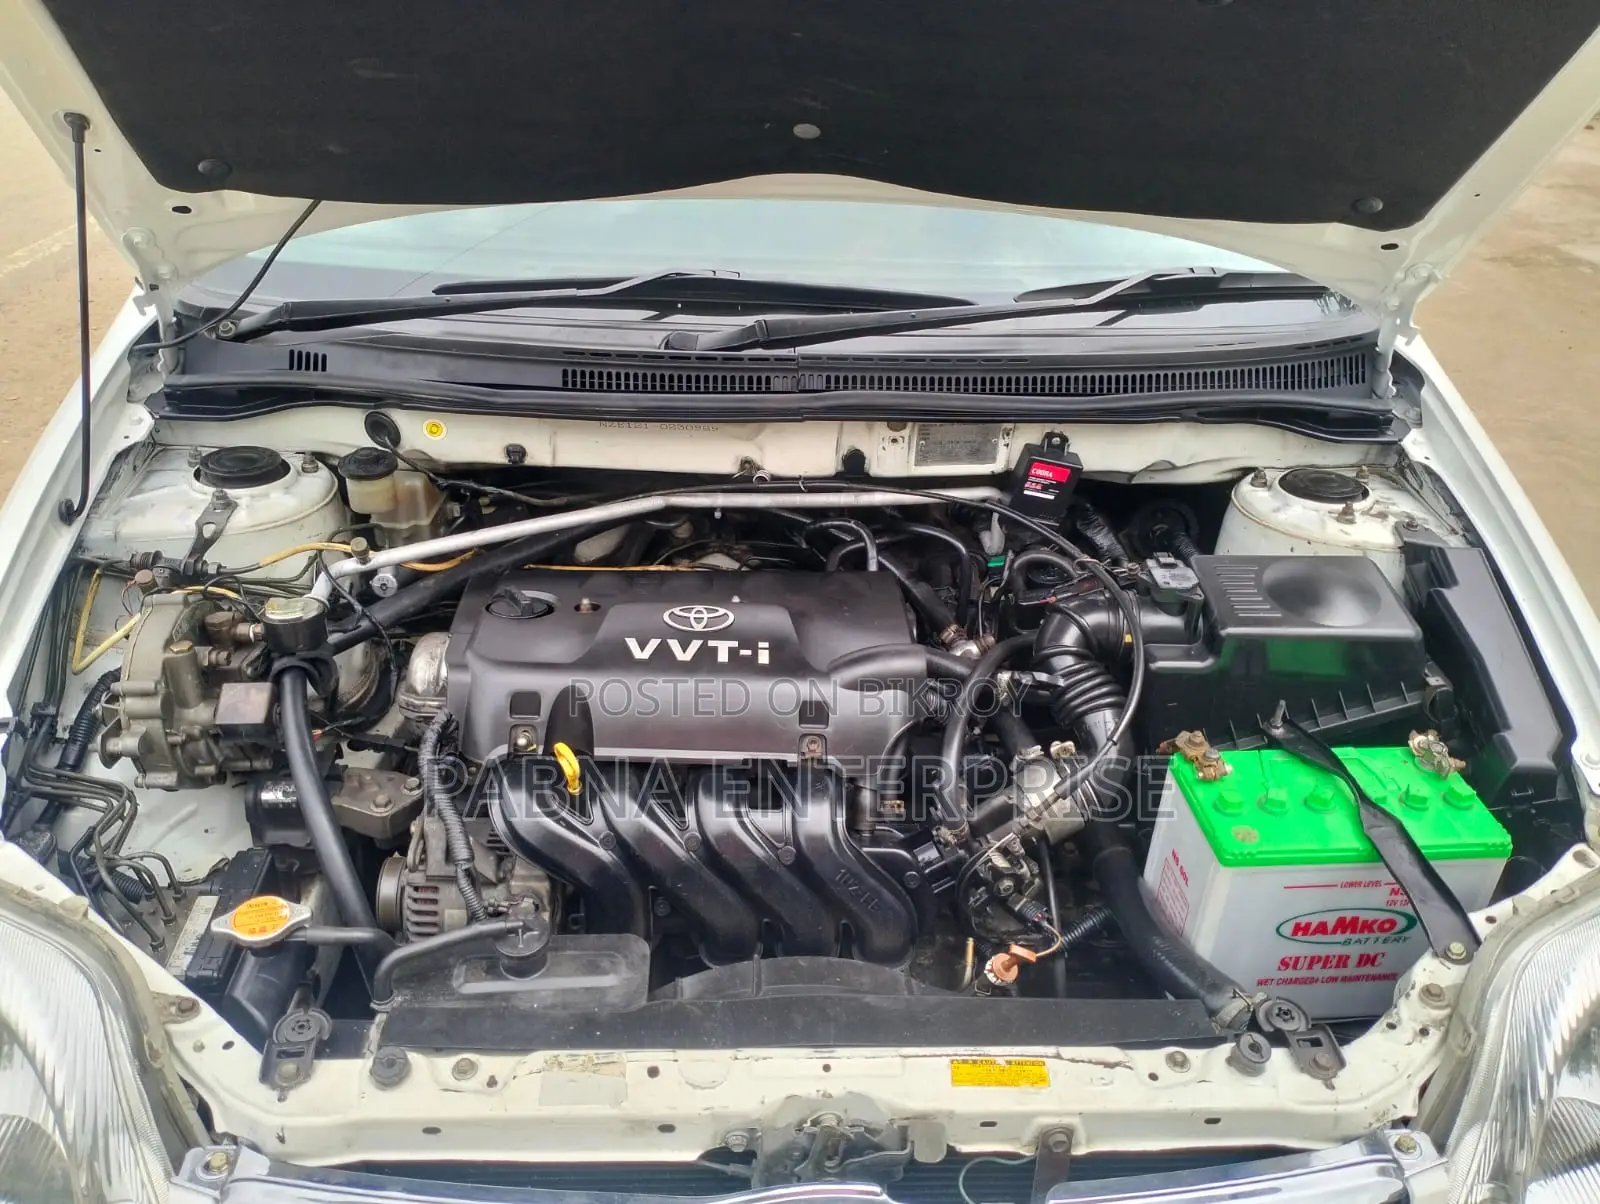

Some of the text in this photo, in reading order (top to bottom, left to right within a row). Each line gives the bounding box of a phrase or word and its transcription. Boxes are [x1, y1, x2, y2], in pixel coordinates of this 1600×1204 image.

[624, 637, 769, 665] VVT-i
[1291, 915, 1397, 937] HAMKO
[1341, 936, 1411, 946] BATTERY
[1276, 951, 1385, 972] SUPER DC
[1256, 978, 1275, 987] WET
[1320, 975, 1338, 984] LOW
[1340, 972, 1399, 983] MAINTENANCE
